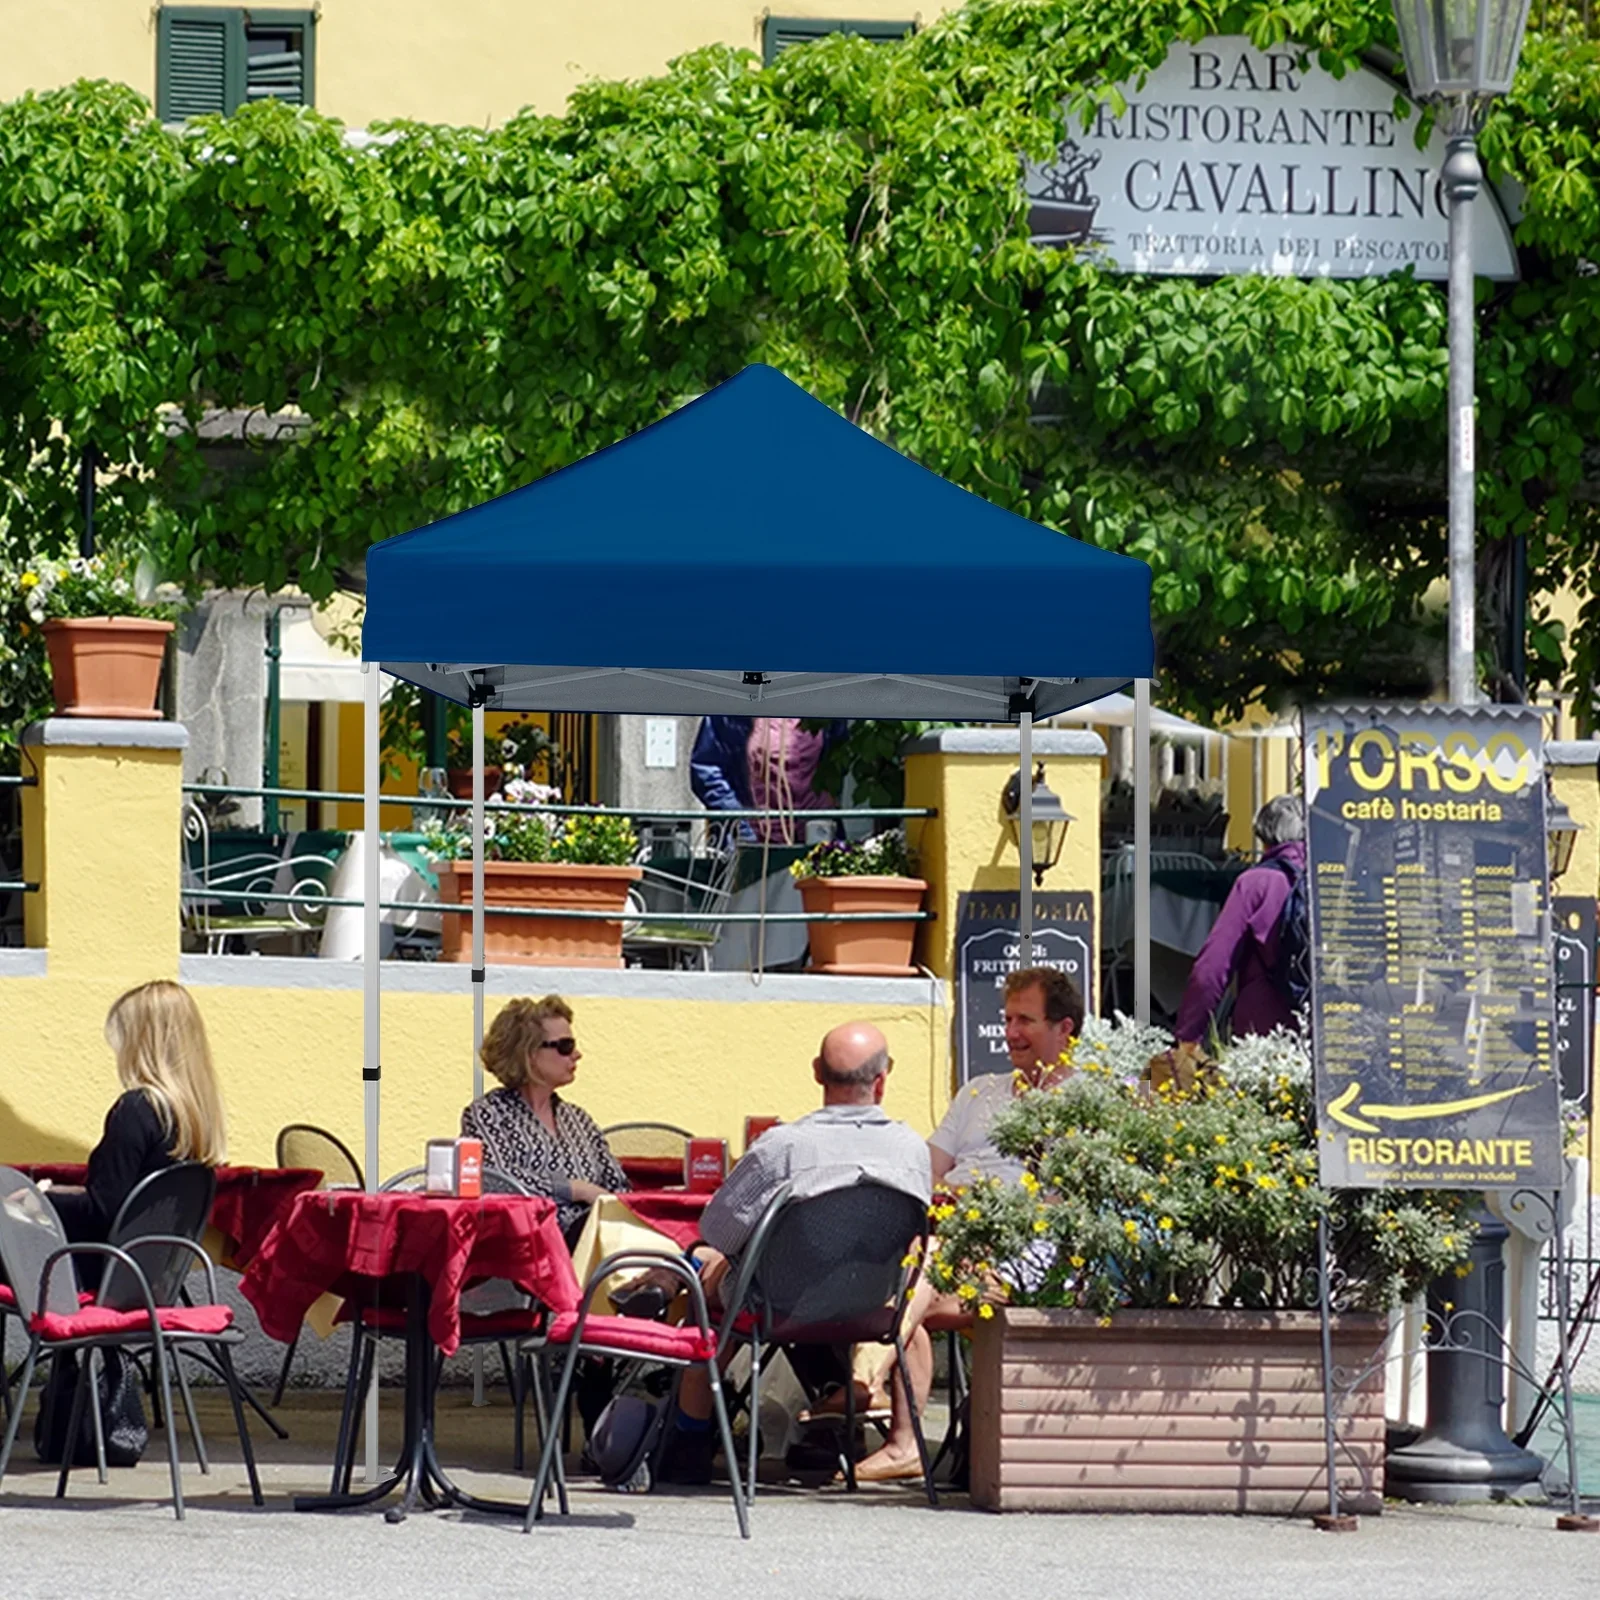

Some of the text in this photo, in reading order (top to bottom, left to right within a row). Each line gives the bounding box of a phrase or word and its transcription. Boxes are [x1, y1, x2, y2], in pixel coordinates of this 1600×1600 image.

[1189, 52, 1301, 91] BAR
[1093, 102, 1395, 147] RISTORANTE
[1128, 232, 1264, 256] TRATTORIA
[1278, 236, 1321, 260] DEI
[1341, 798, 1503, 821] cafè hostaria
[968, 901, 1088, 921] TRATORIA
[973, 960, 1021, 973] FRITT
[1347, 1138, 1533, 1167] RISTORANTE
